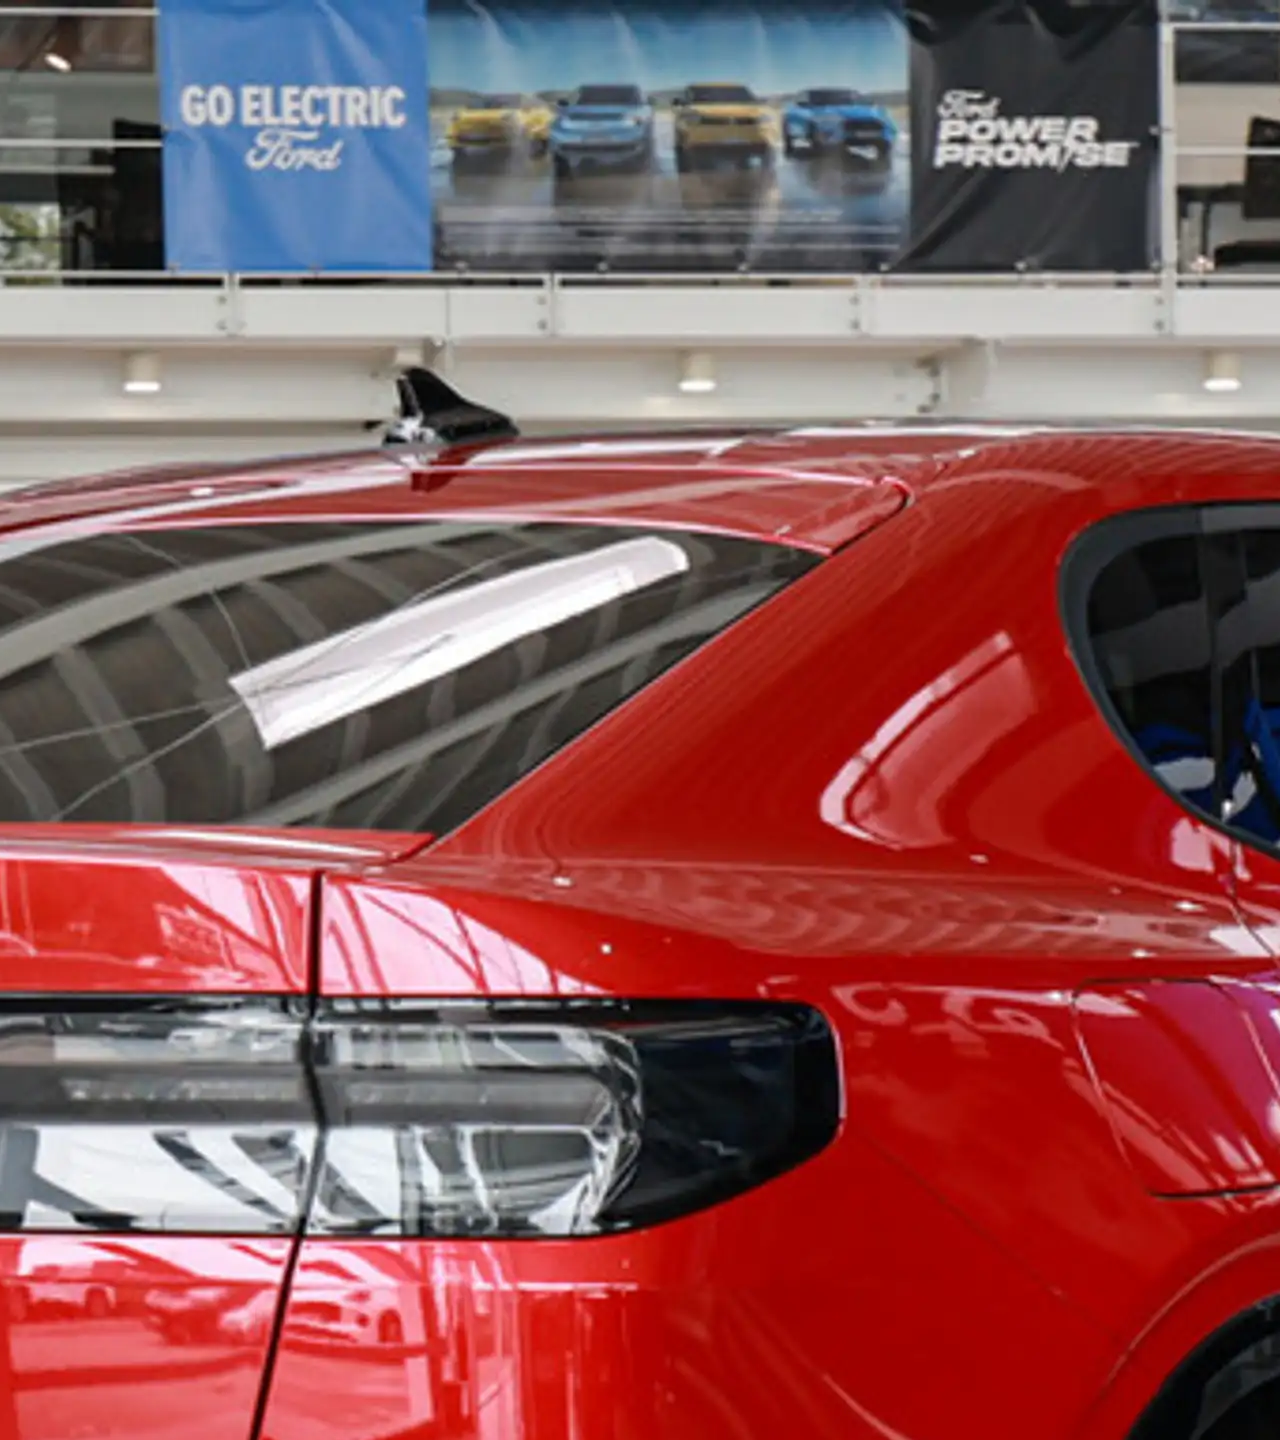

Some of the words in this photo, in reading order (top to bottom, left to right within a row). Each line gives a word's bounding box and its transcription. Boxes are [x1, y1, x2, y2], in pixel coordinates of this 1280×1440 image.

[181, 85, 235, 127] GO
[240, 85, 408, 128] ELECTRIC
[245, 127, 344, 170] Ford
[939, 115, 1099, 143] POWER
